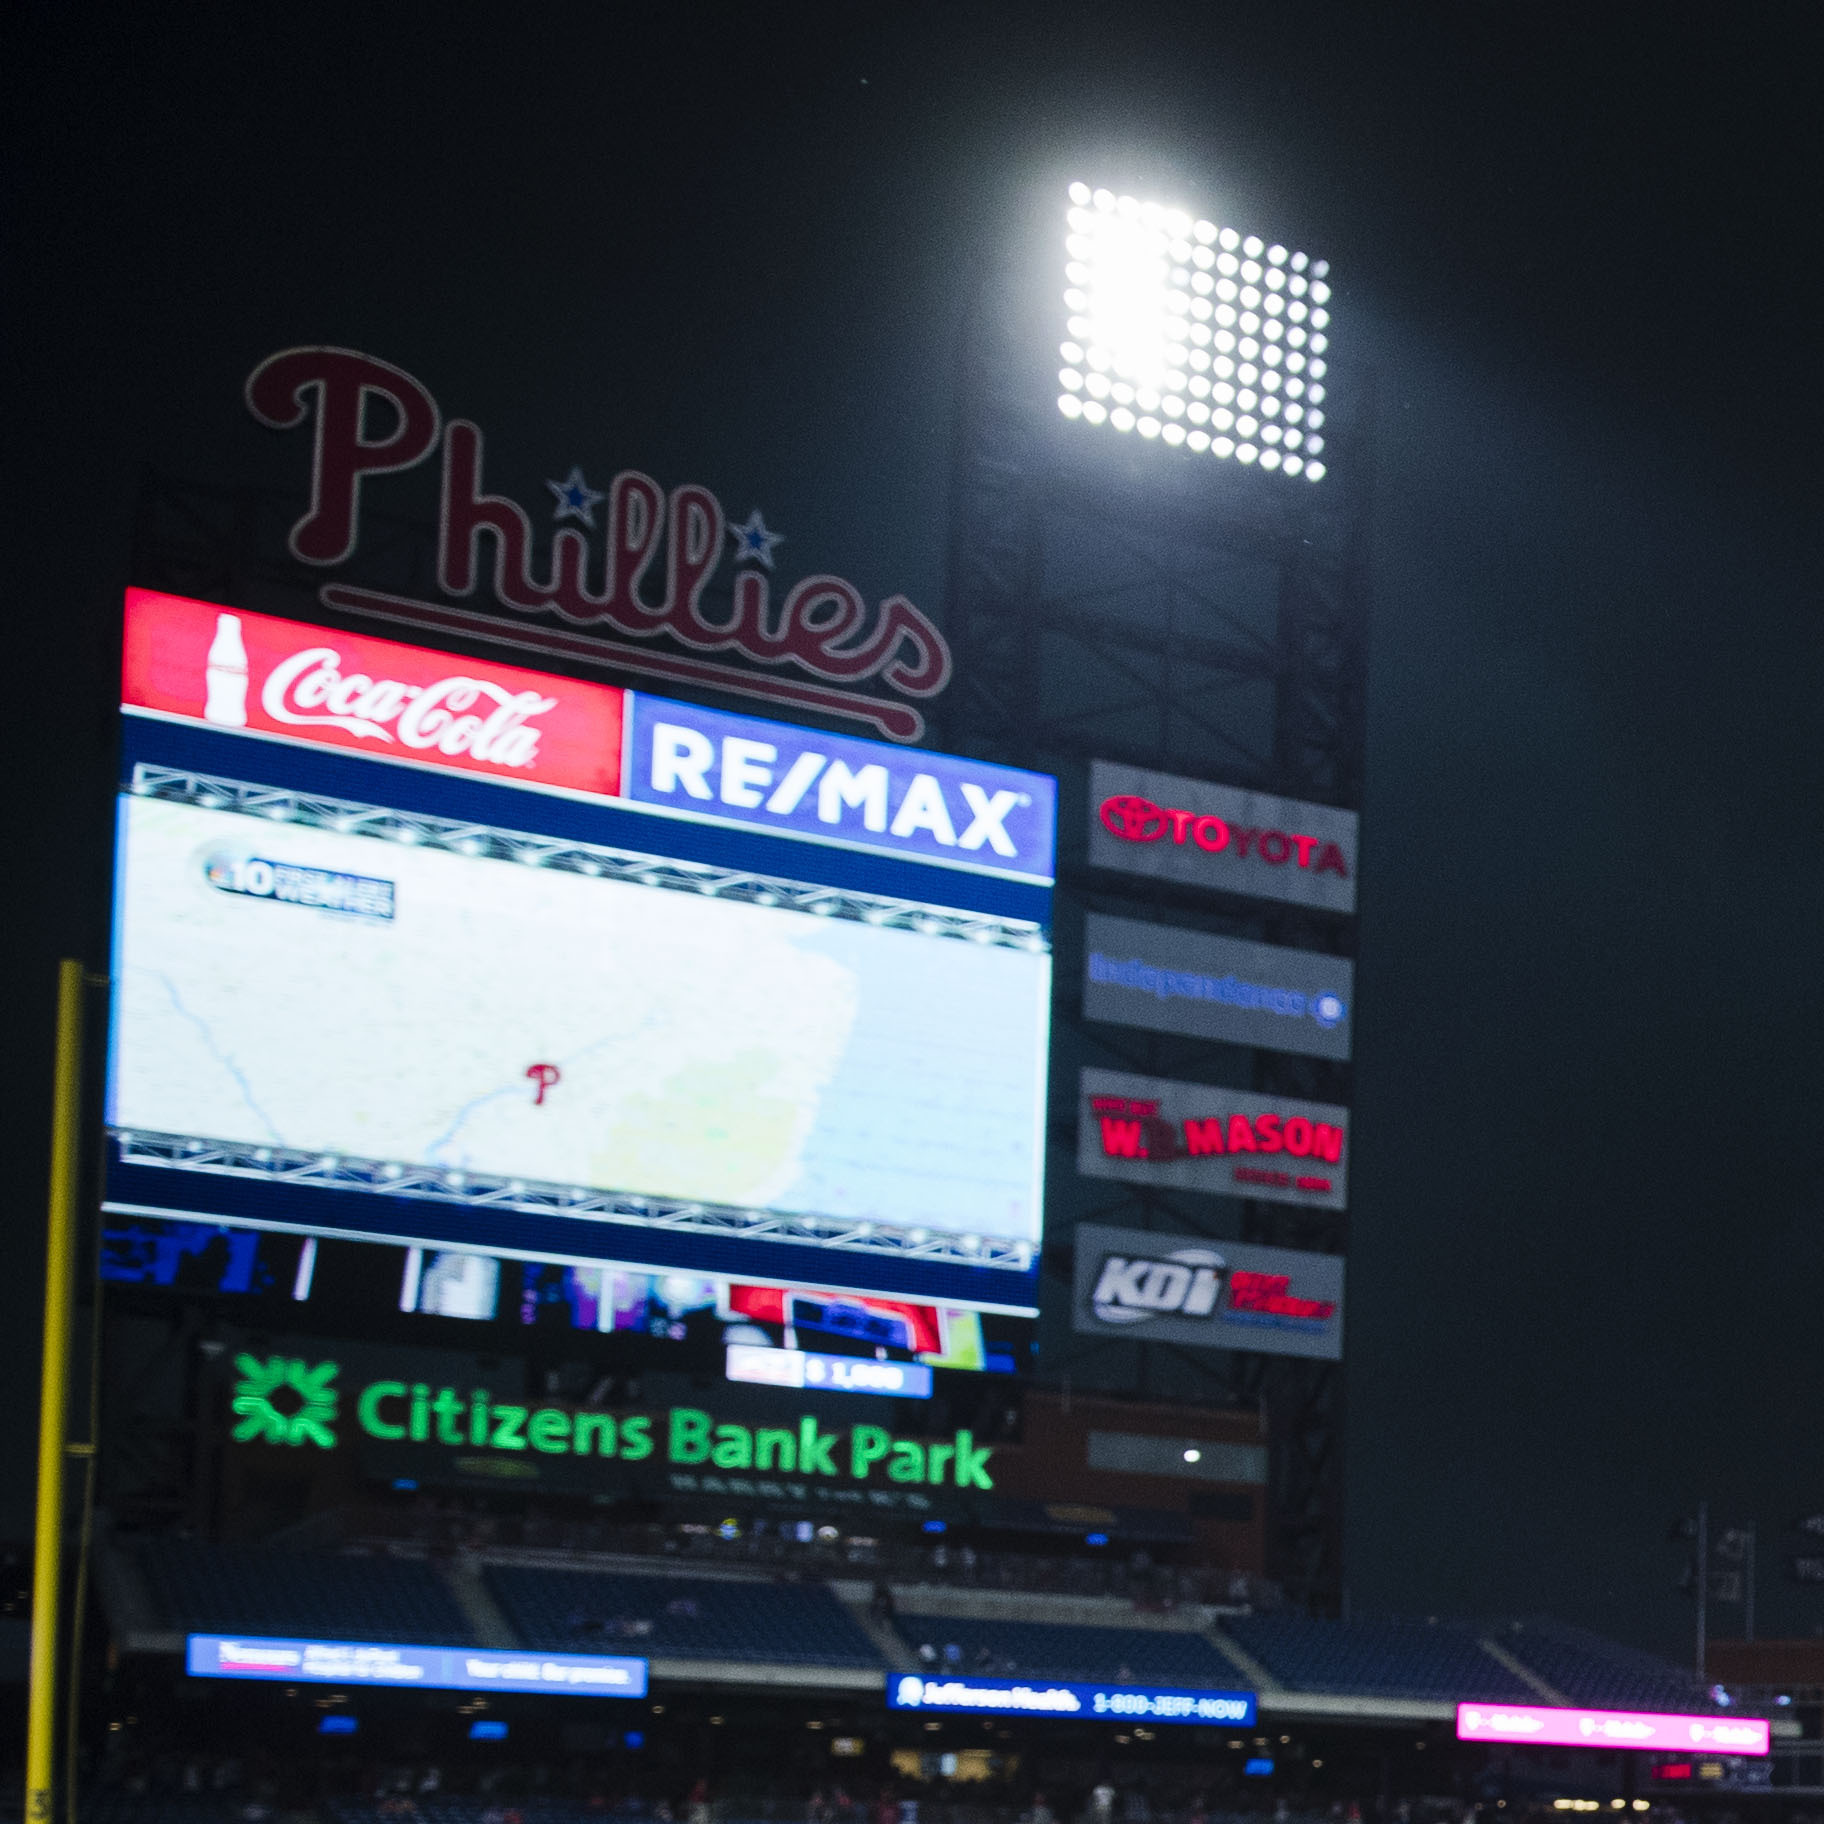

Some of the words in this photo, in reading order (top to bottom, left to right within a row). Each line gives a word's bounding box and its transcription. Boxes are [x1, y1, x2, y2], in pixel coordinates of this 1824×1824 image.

[246, 346, 952, 697] Phillies
[262, 646, 558, 768] Coca-Cola
[651, 722, 1019, 856] RE/MAX
[1168, 809, 1347, 878] TOYOTA
[356, 1378, 654, 1462] Citizens
[668, 1407, 838, 1478] Bank
[850, 1424, 995, 1491] Park
